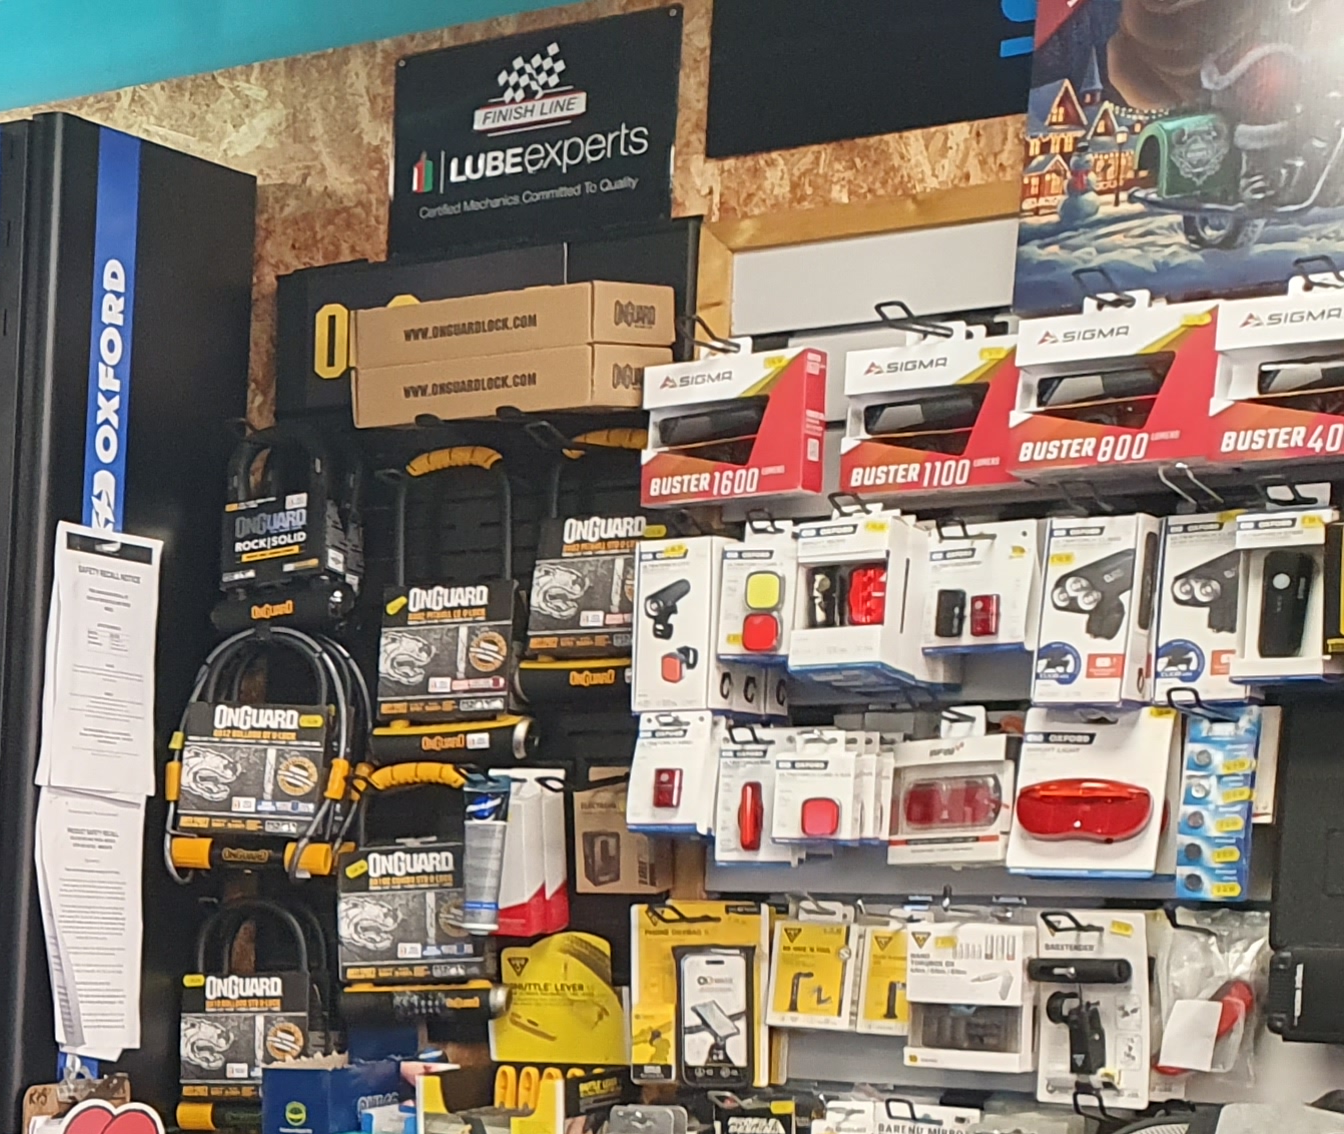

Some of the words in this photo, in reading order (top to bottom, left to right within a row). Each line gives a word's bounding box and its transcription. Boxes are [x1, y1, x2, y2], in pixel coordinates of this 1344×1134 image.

[482, 102, 534, 126] FINISH
[540, 97, 577, 115] LINE
[450, 122, 648, 182] LUBEexperts
[419, 201, 461, 219] Certified
[463, 193, 520, 211] Mechanics
[522, 184, 582, 203] Committed
[585, 181, 597, 193] To
[600, 176, 638, 191] Quality
[1266, 308, 1343, 325] SIGMA
[1063, 326, 1129, 343] SIGMA
[93, 258, 126, 464] OXFORD
[886, 357, 947, 373] SIGMA
[679, 371, 733, 387] SIGMA
[1018, 438, 1096, 463] BUSTER
[1097, 433, 1150, 462] 800
[1220, 426, 1306, 453] BUSTER
[649, 474, 710, 497] BUSTER
[711, 468, 759, 495] 1600
[850, 463, 919, 487] BUSTER
[922, 459, 971, 487] 1100
